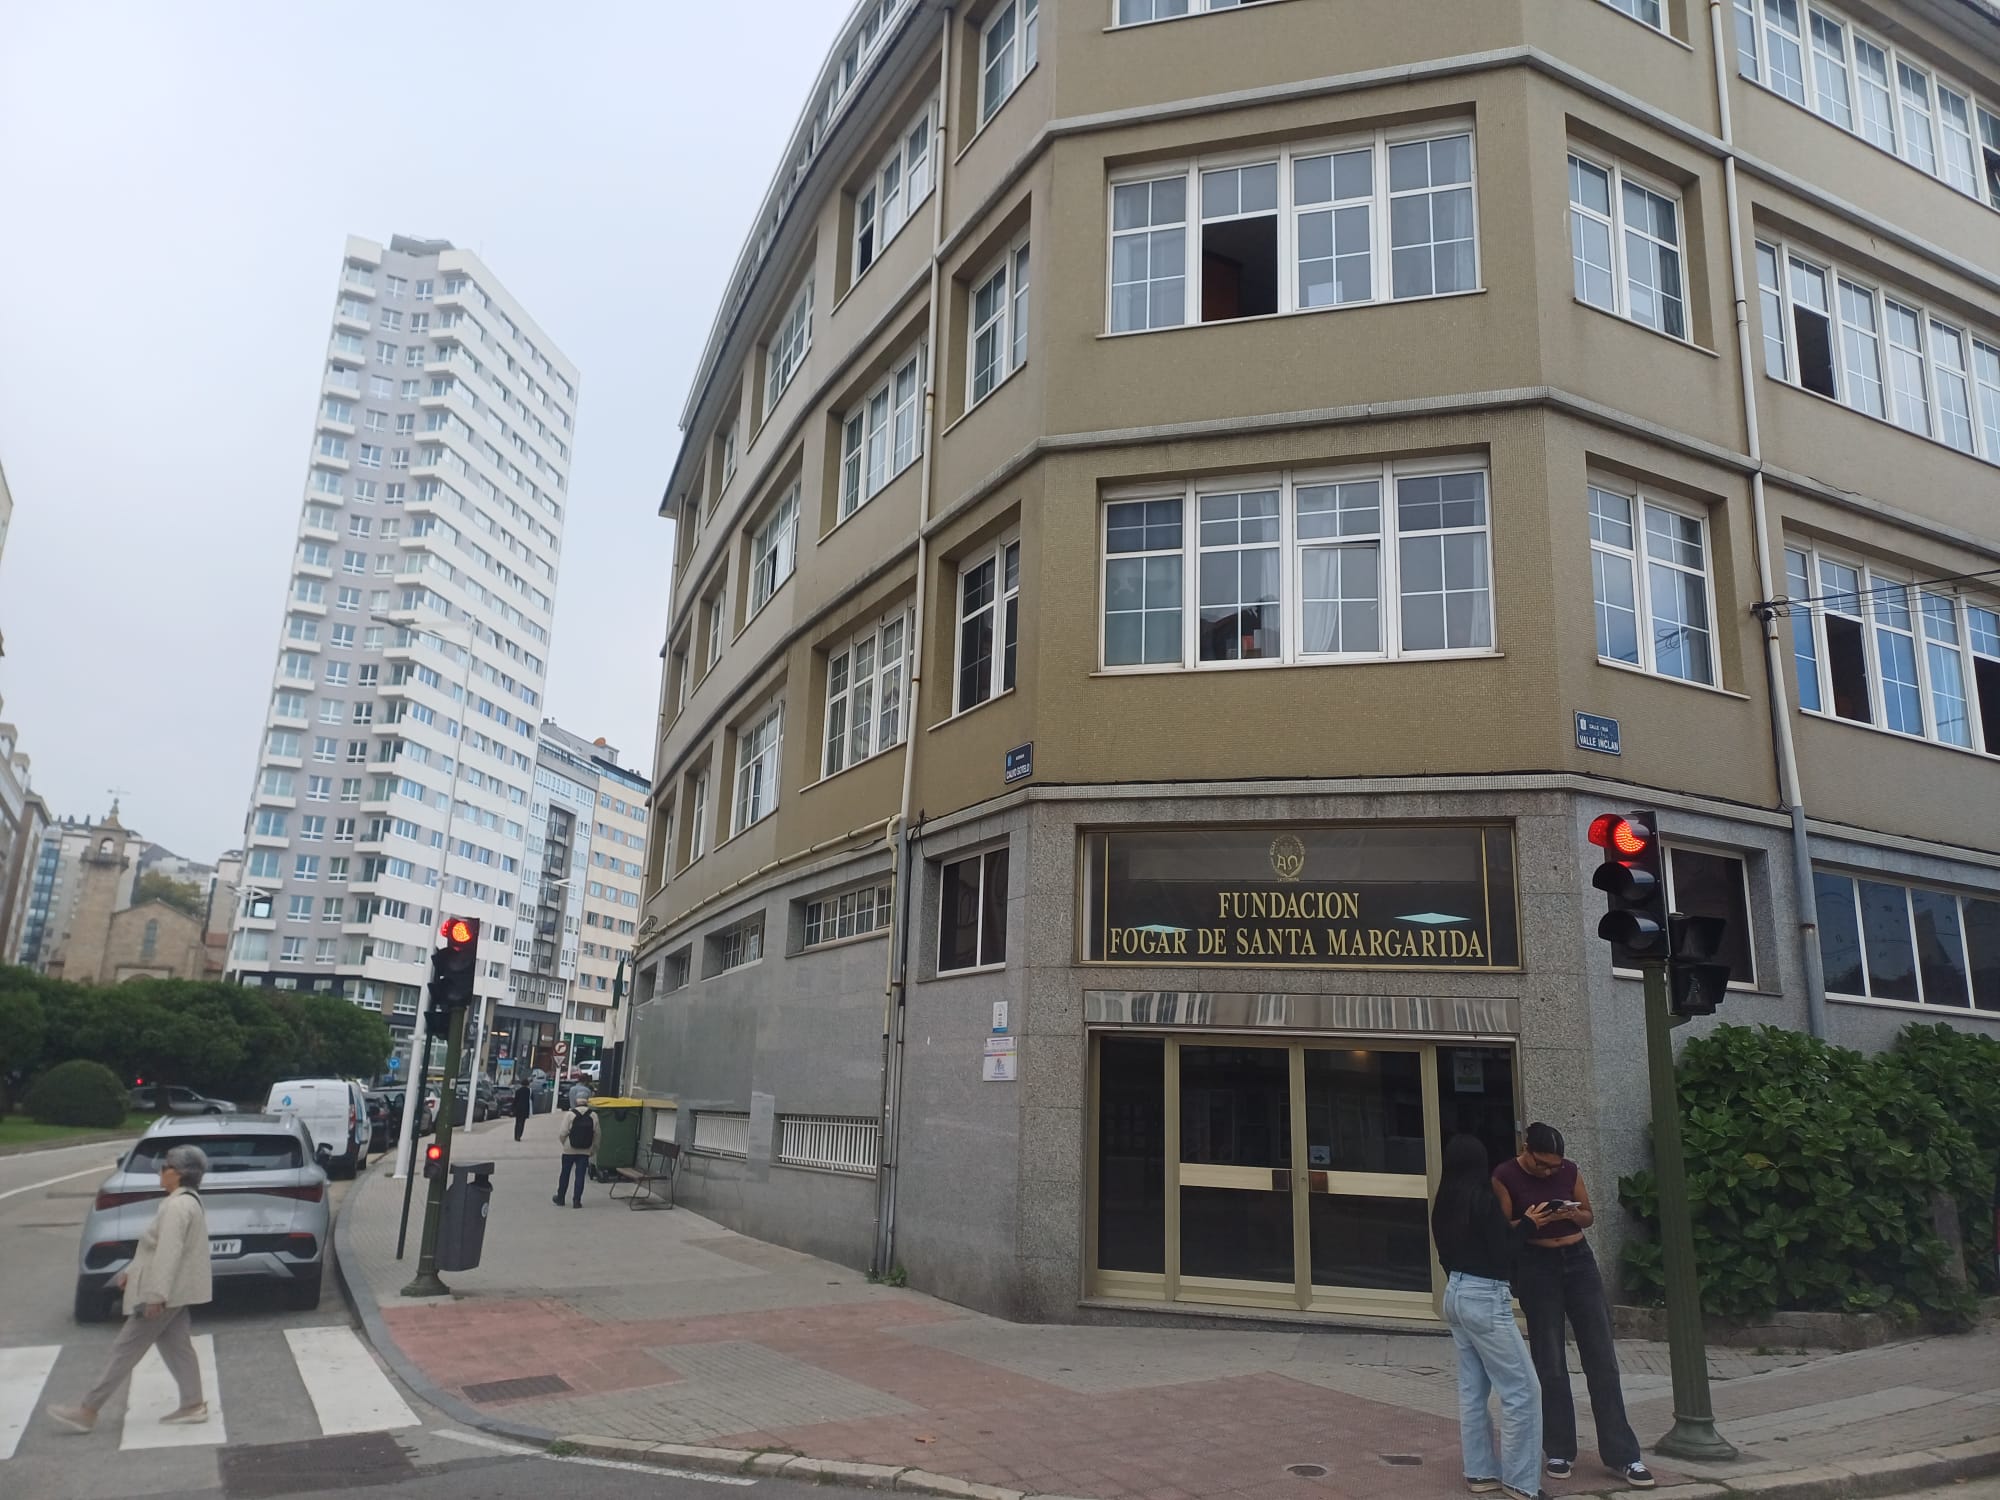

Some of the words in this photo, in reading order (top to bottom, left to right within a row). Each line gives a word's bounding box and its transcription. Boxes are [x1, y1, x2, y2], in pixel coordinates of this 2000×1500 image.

[1580, 735, 1597, 746] VALLE
[1218, 891, 1360, 920] FUNDACION
[1110, 927, 1187, 954] FOGAR
[1197, 928, 1227, 955] DE
[1236, 928, 1318, 956] SANTA
[1327, 928, 1486, 959] MARGARIDA
